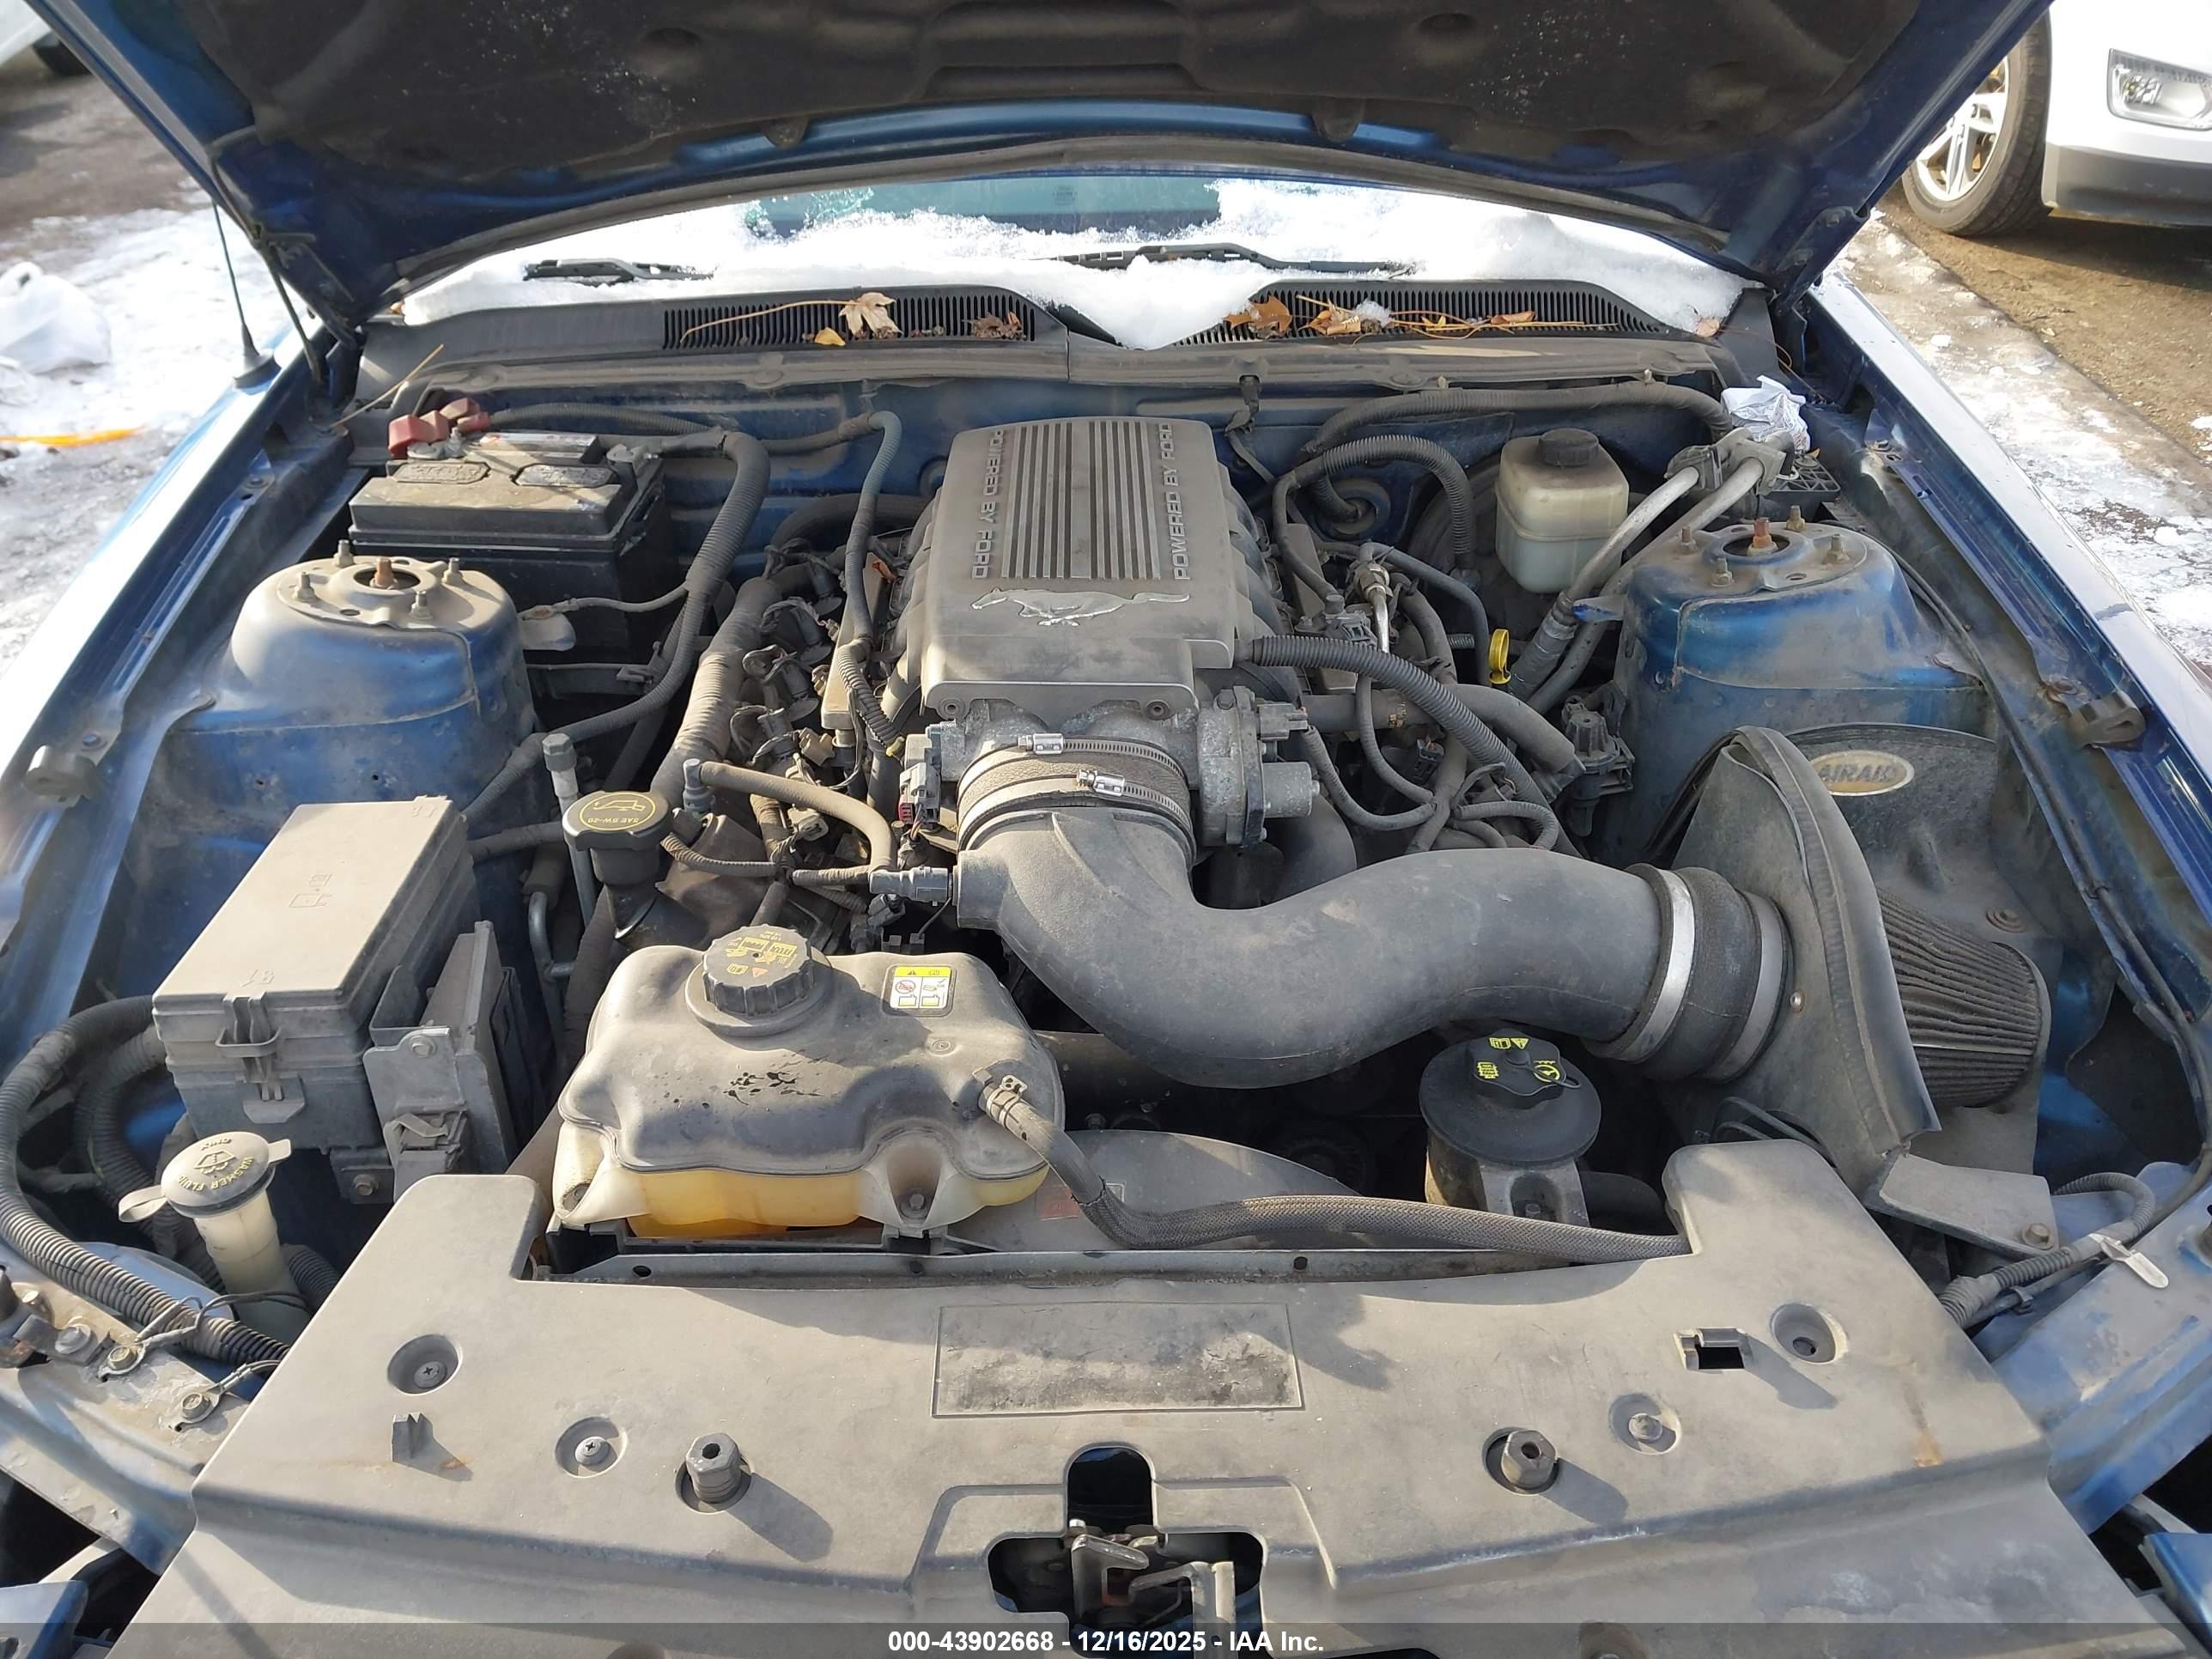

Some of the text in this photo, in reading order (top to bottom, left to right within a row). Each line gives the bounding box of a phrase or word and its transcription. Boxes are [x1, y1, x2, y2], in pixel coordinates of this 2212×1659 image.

[972, 430, 1004, 579] POWERED BY FORD
[1159, 423, 1190, 580] POWERED BY FORD
[178, 1157, 254, 1192] WASHER FLUID
